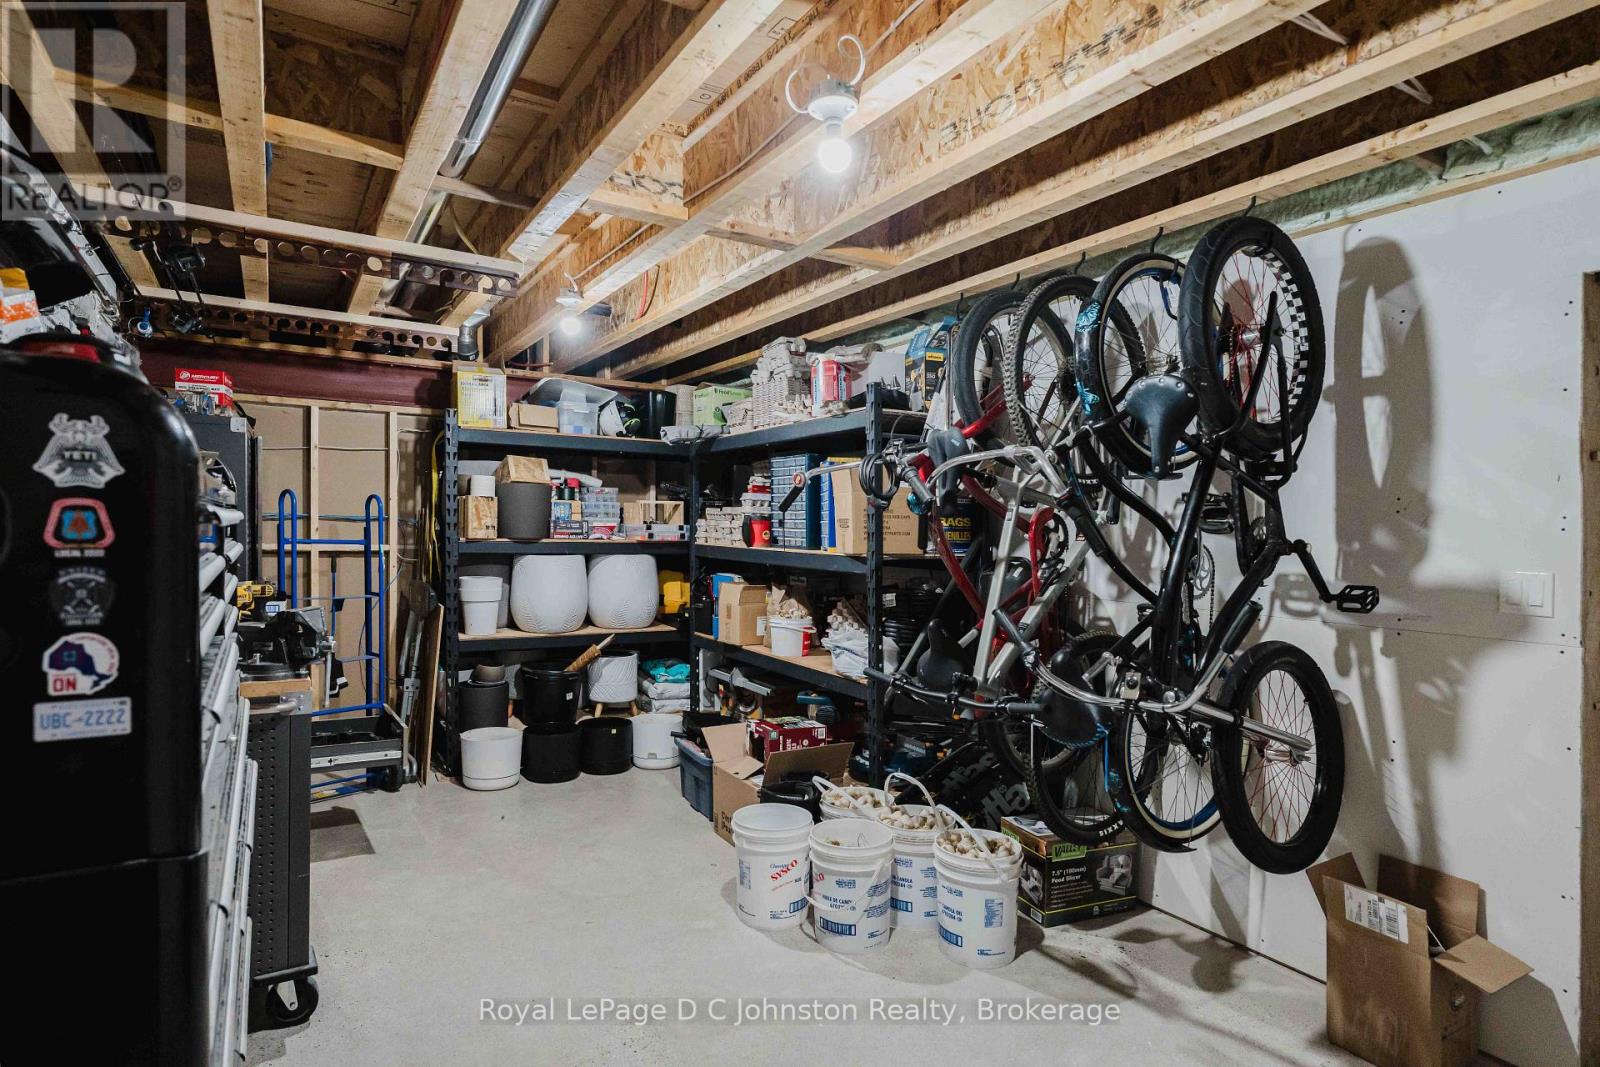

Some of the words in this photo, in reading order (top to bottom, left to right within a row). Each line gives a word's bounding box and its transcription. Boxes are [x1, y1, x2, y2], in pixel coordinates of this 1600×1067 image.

[64, 451, 97, 460] YETI
[53, 678, 77, 693] ON
[40, 708, 126, 730] UBC-2222
[770, 859, 798, 881] SYSCO
